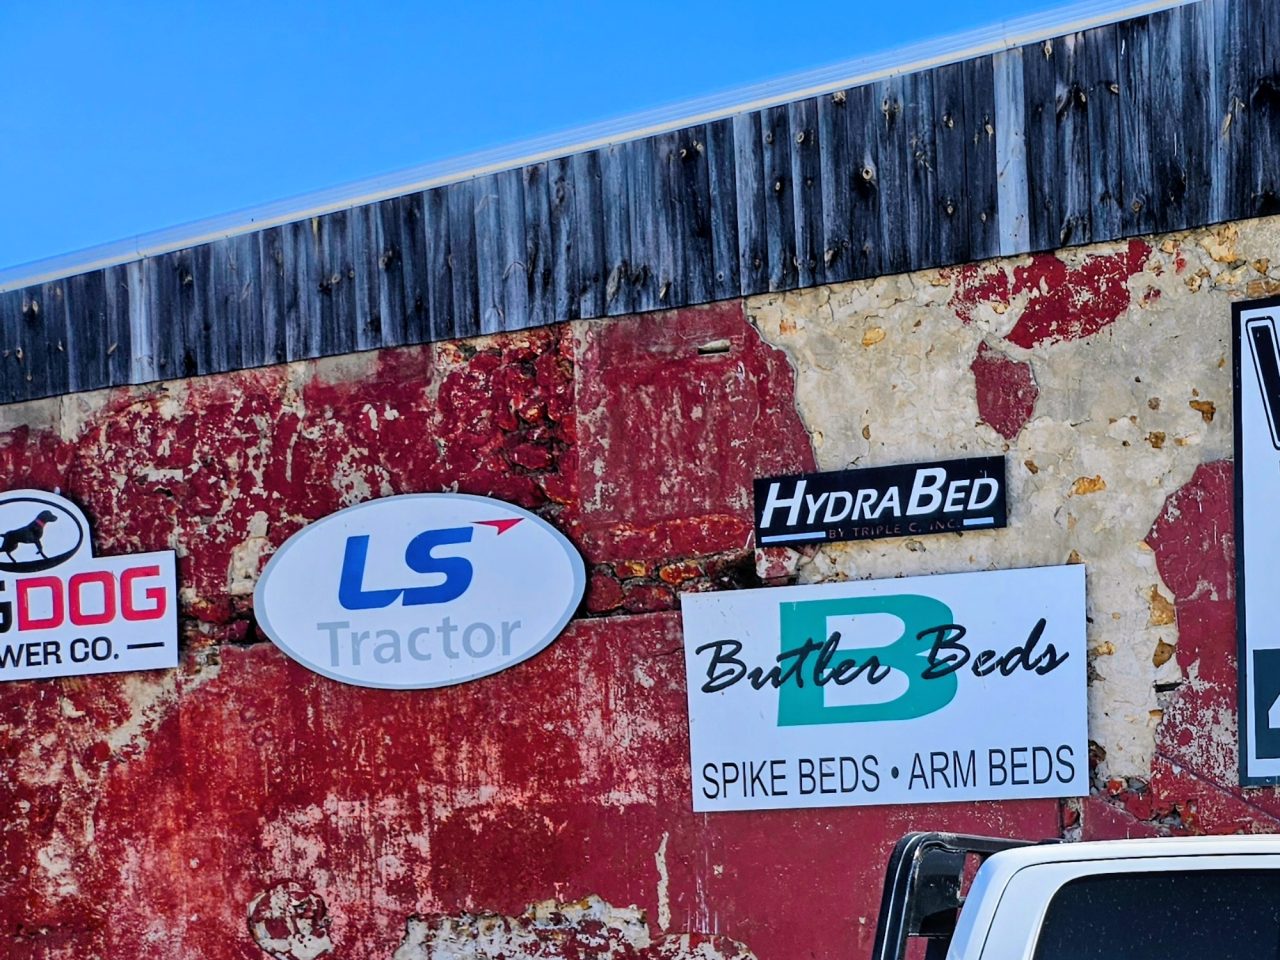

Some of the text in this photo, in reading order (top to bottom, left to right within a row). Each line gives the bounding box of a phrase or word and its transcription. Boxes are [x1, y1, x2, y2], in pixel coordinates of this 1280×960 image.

[828, 528, 845, 539] BY
[854, 524, 901, 536] TRIPLE
[338, 526, 473, 610] LS
[0, 565, 167, 633] DOG
[70, 636, 119, 663] CO.
[317, 616, 522, 668] Tractor
[695, 618, 1070, 694] Butler Beds
[702, 744, 1075, 800] SPIKE BEDS ARM BEDS
